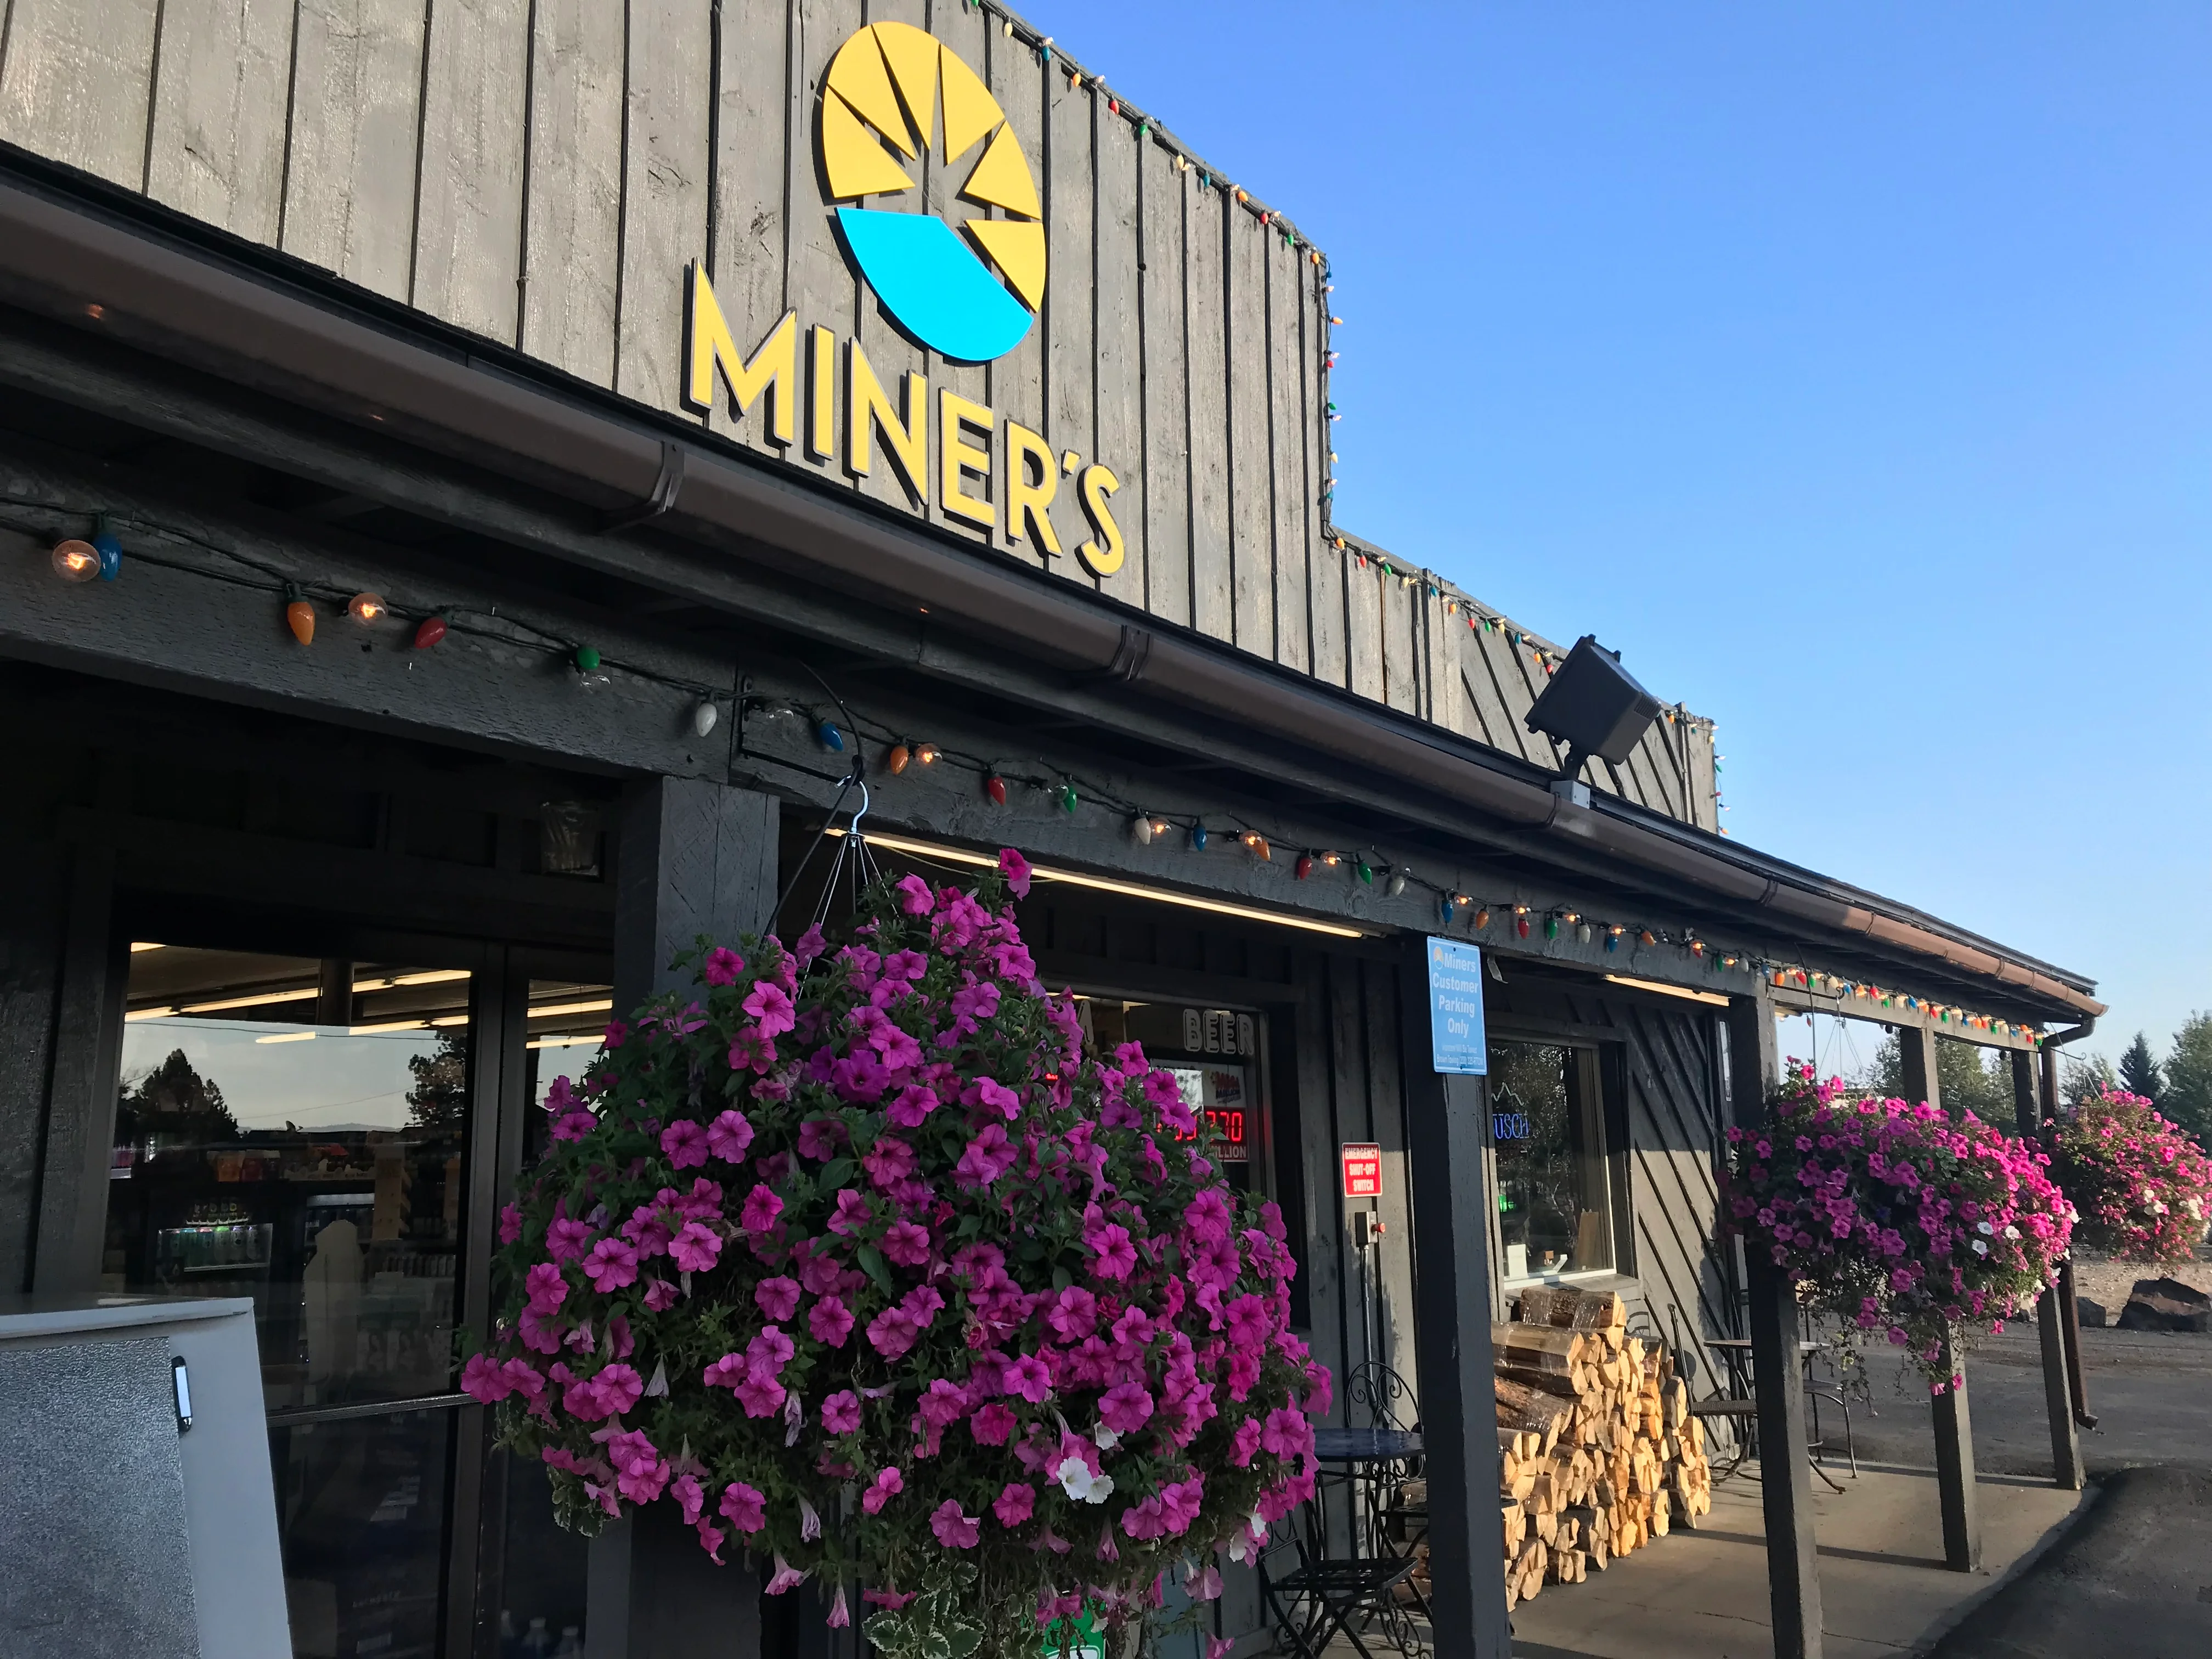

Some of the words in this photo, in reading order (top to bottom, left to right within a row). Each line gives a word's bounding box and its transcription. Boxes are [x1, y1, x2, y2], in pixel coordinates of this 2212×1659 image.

[690, 256, 1124, 578] MINER'S
[1443, 953, 1476, 972] Miners
[1432, 972, 1479, 994] Customer
[1438, 995, 1475, 1018] Parking
[1183, 1008, 1254, 1055] BEER
[1447, 1018, 1469, 1038] Only
[1492, 1114, 1530, 1139] USCH
[1211, 1145, 1246, 1158] ILLION
[1345, 1148, 1378, 1159] EMERGENCY
[1349, 1163, 1376, 1176] SHUT-OFF
[1353, 1179, 1374, 1192] SWITCH
